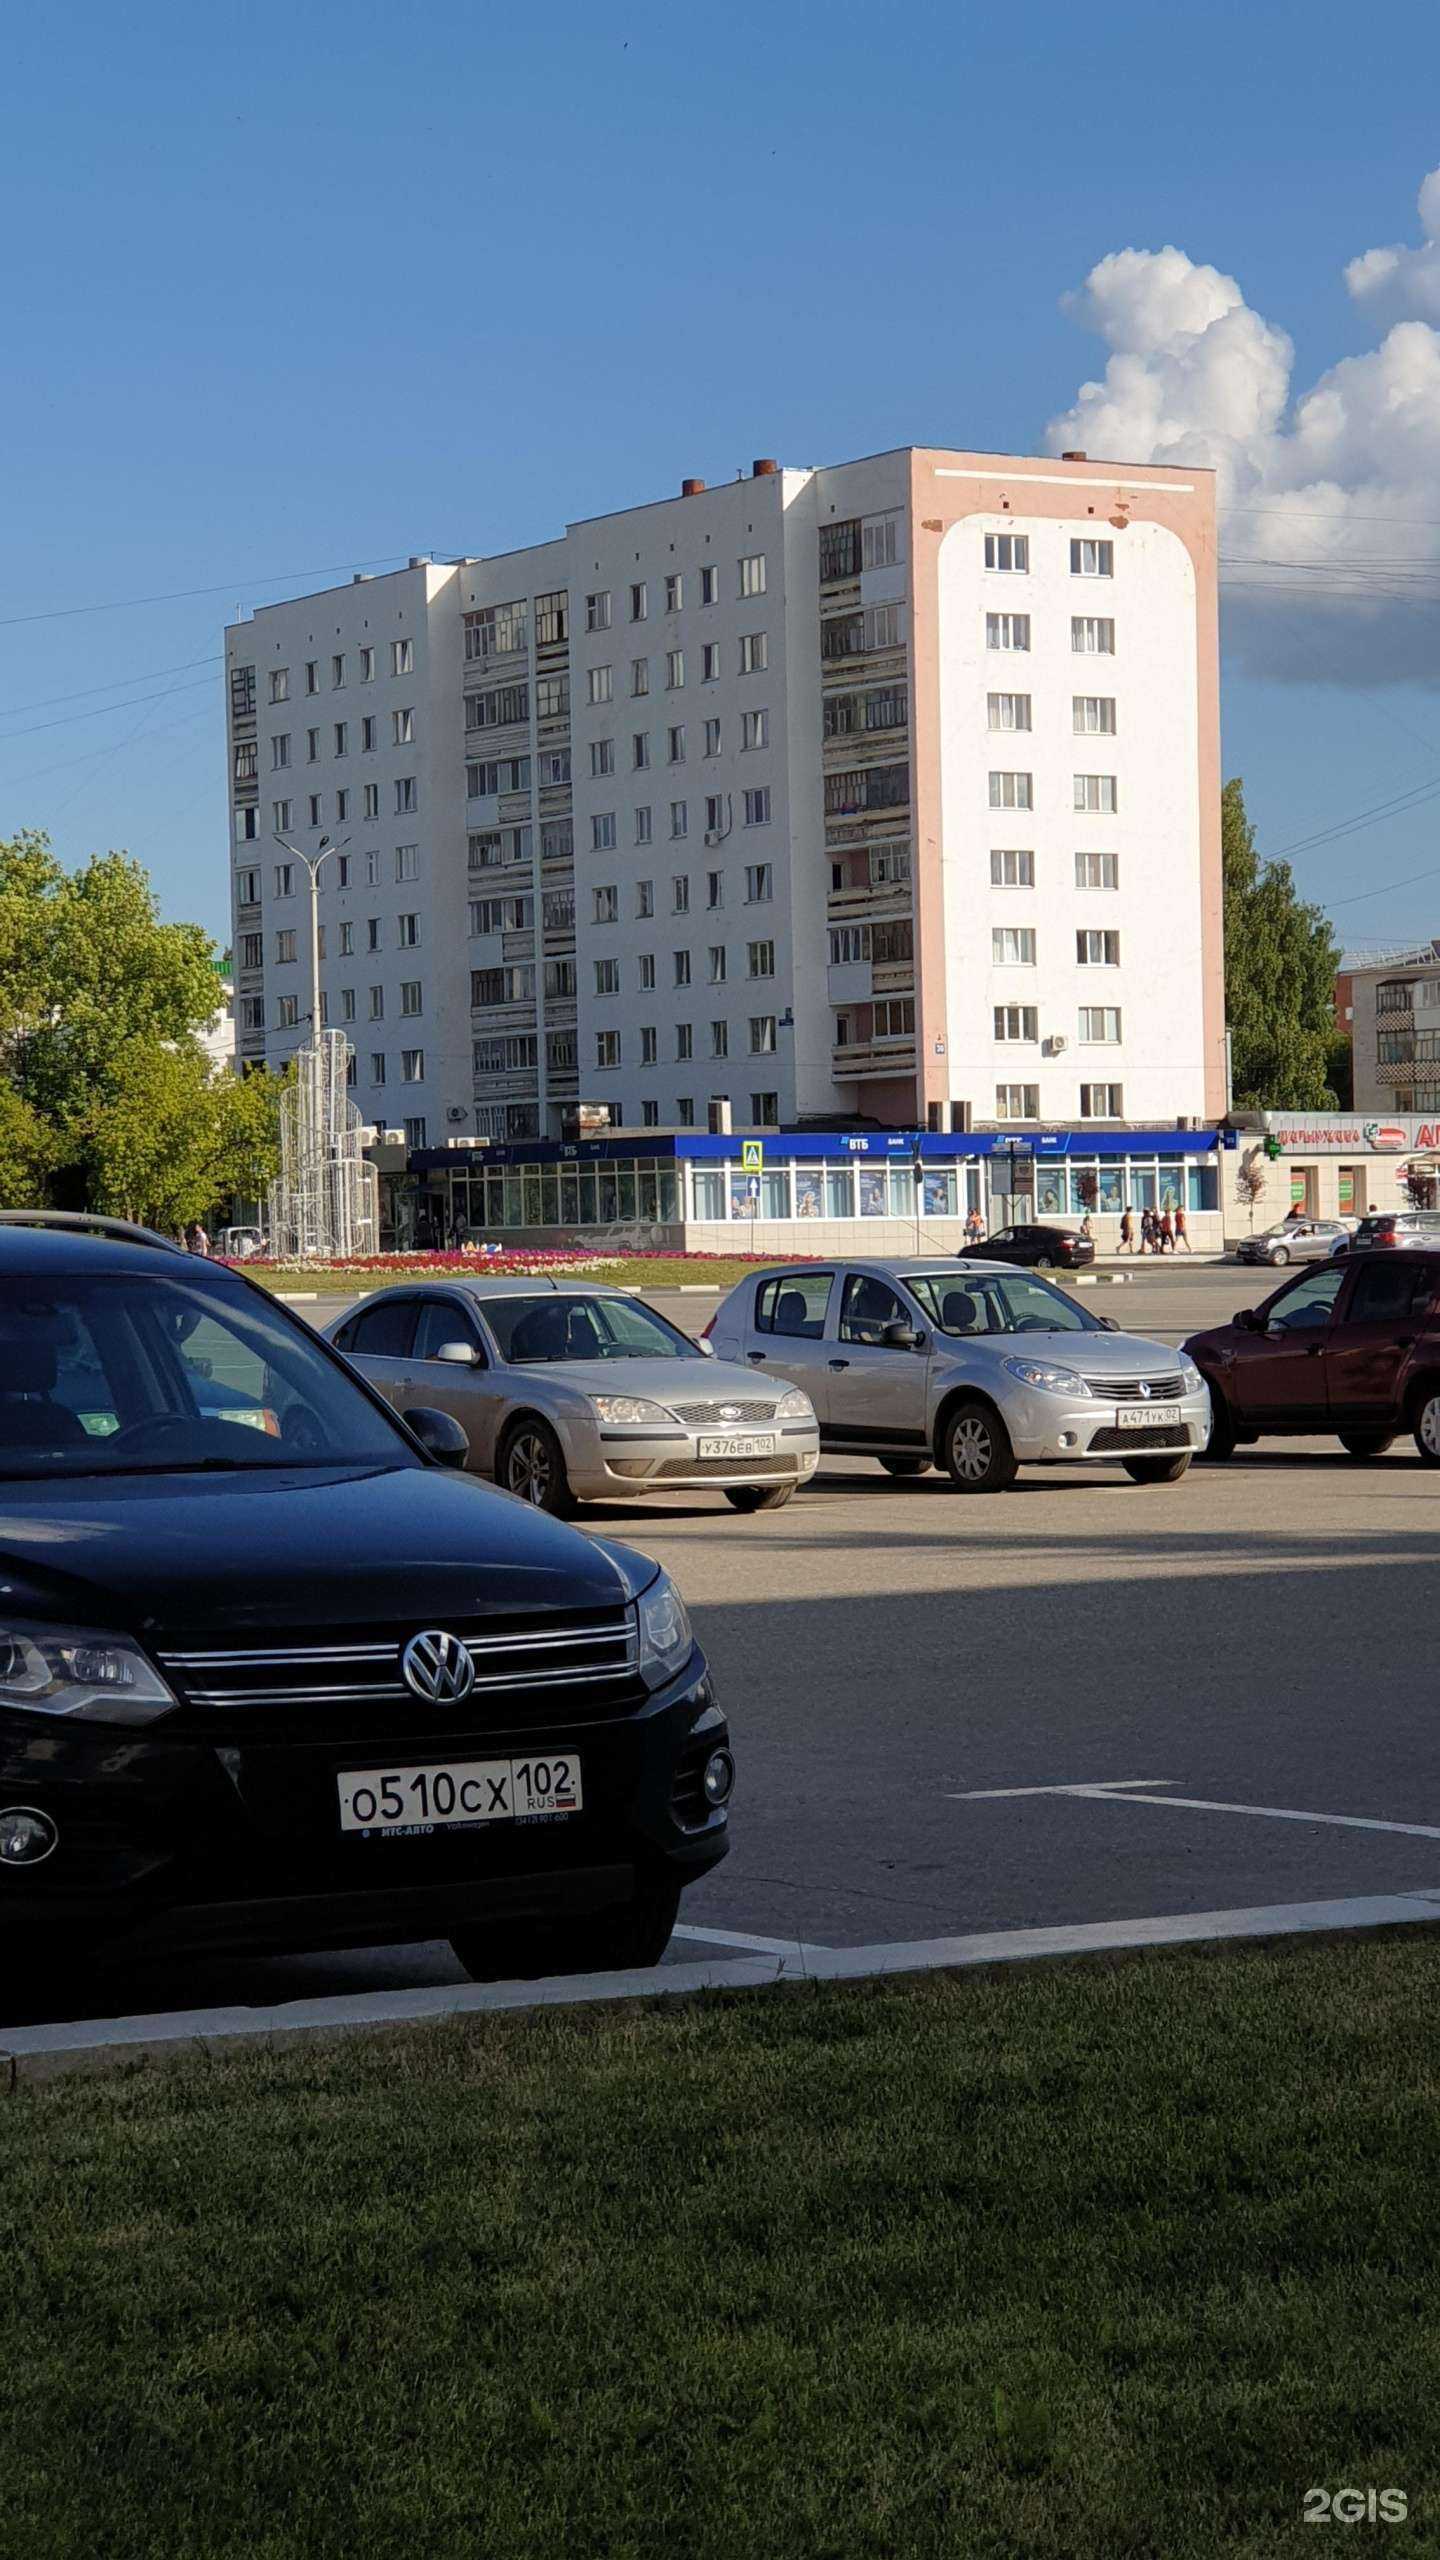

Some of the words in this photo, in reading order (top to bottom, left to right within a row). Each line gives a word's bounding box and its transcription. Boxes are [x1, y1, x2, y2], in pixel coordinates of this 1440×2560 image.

[849, 1138, 869, 1150] ВТБ
[704, 1440, 752, 1454] У376ЕВ
[754, 1438, 771, 1449] 102
[351, 1772, 509, 1822] О510СХ
[516, 1760, 571, 1797] 102
[528, 1795, 555, 1809] RUS
